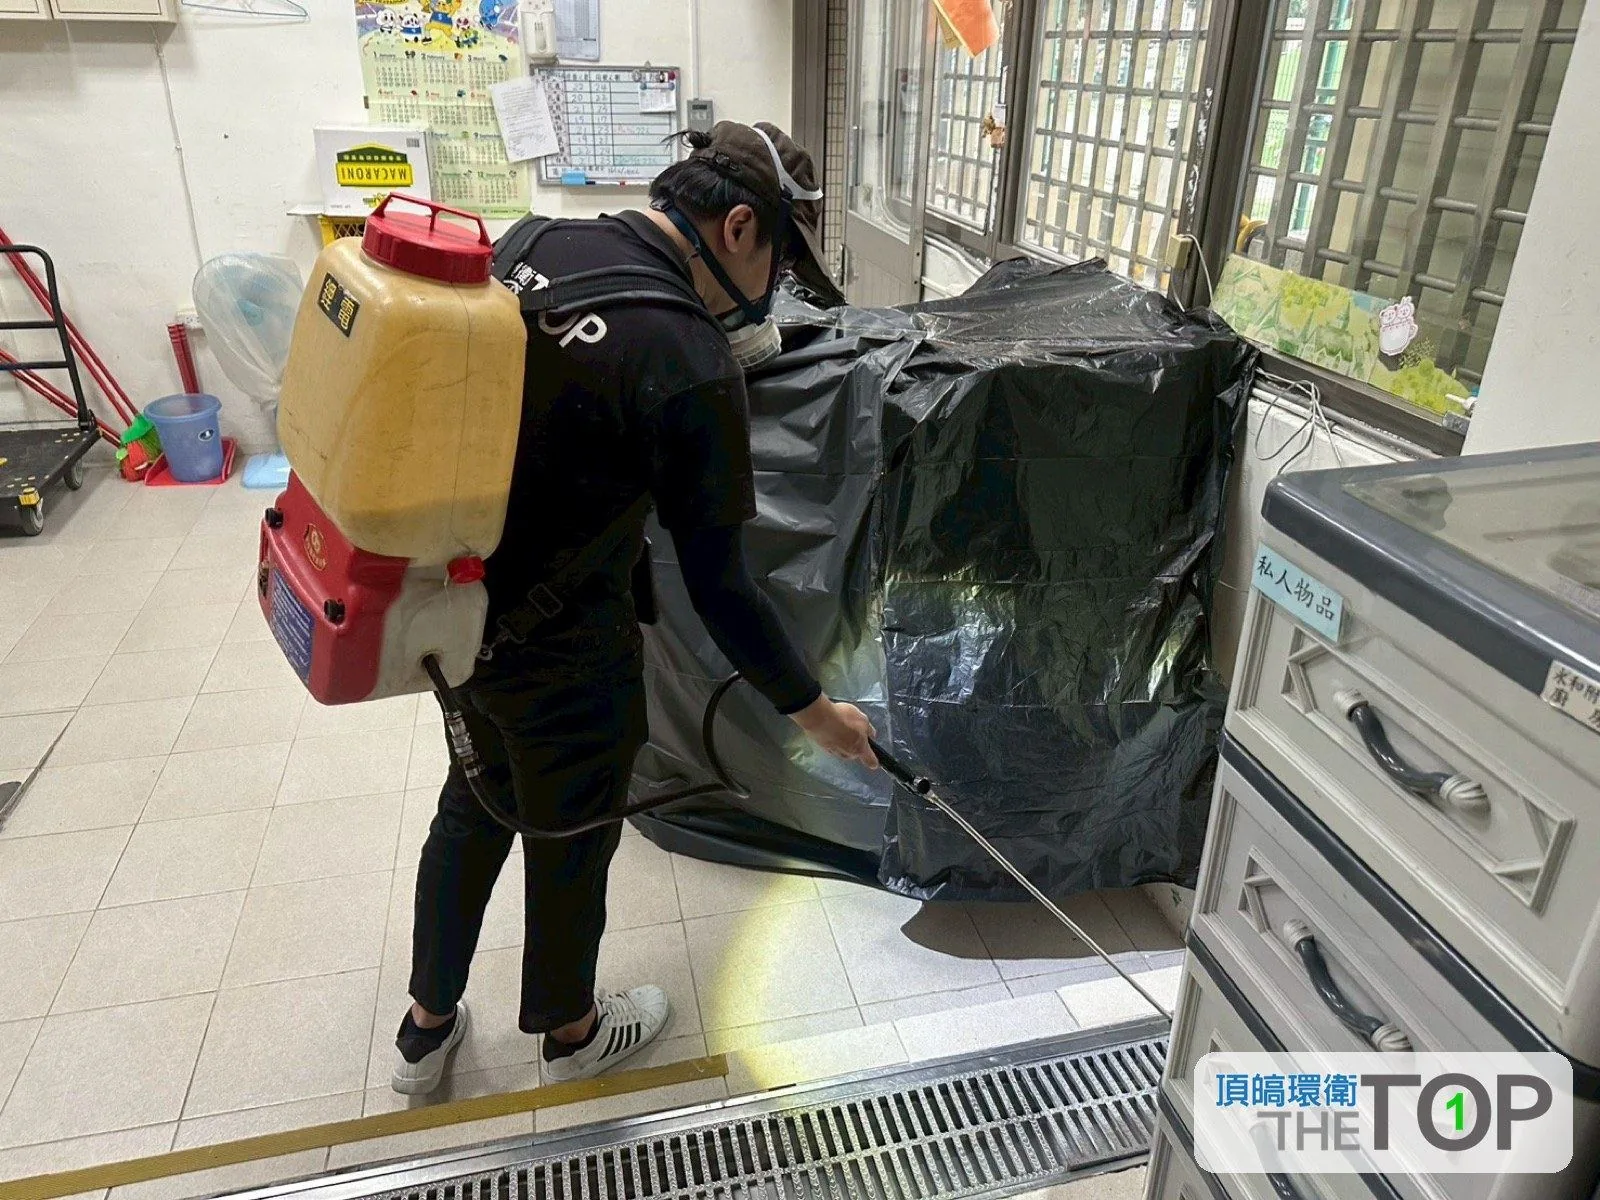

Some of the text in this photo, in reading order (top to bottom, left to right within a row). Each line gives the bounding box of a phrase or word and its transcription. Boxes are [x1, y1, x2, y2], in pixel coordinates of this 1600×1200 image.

[341, 166, 407, 181] MACARONI
[1256, 555, 1335, 621] 私人物品
